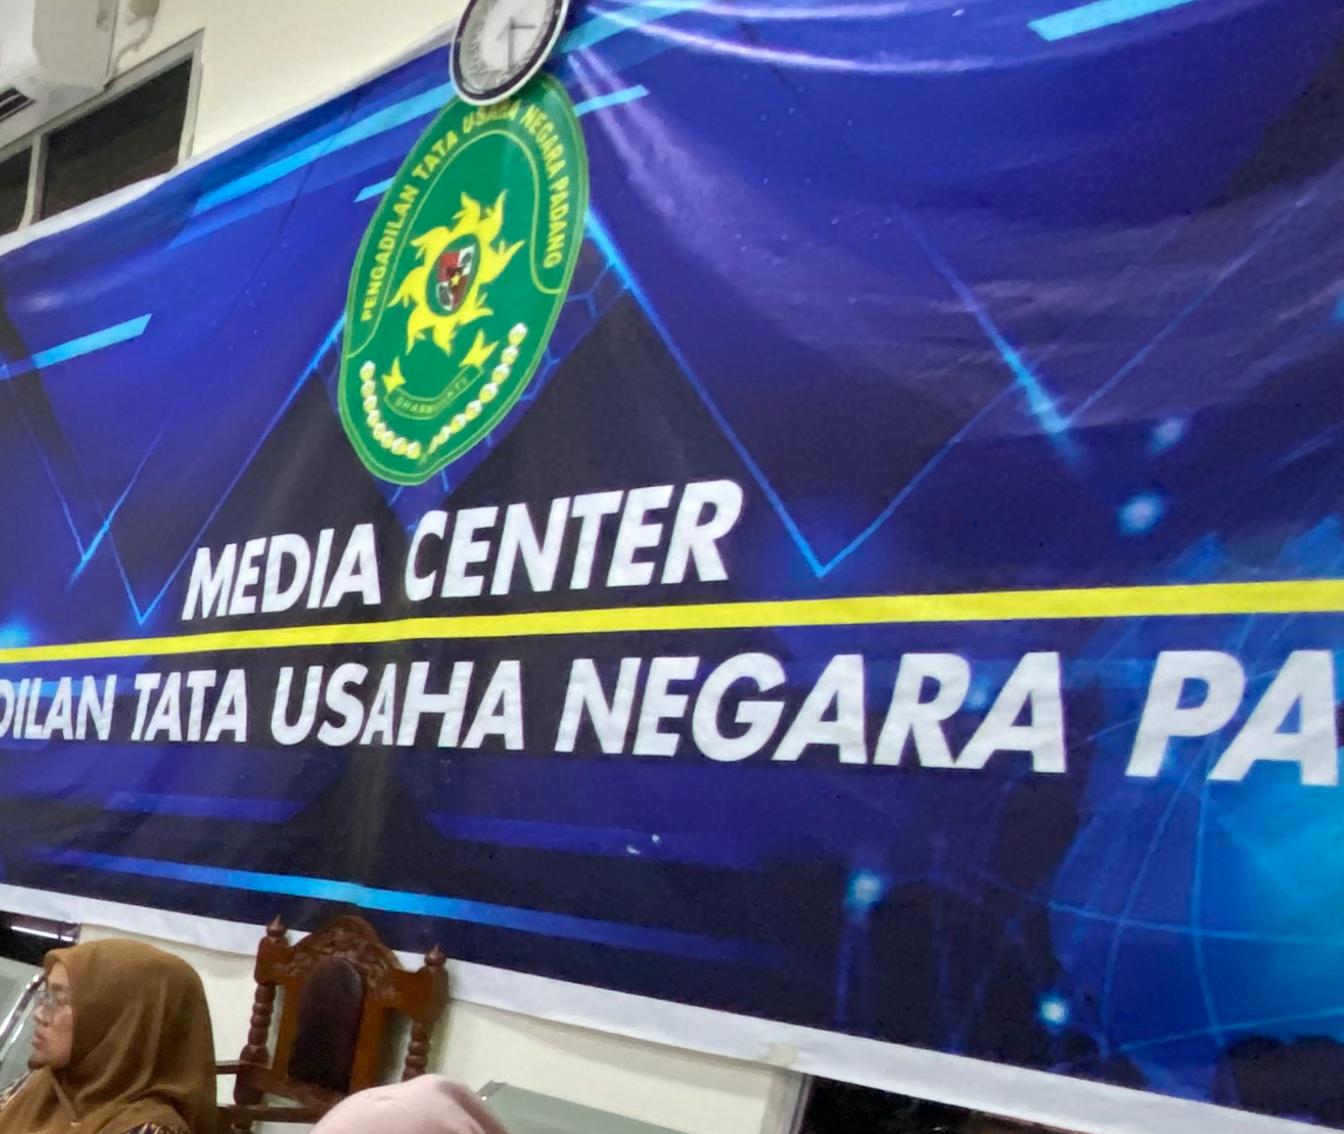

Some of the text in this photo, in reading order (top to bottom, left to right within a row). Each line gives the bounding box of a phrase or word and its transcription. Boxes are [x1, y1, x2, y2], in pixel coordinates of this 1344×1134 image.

[361, 184, 419, 321] PENGADILAN
[412, 130, 458, 180] TATA
[519, 104, 566, 179] NEGARA
[544, 176, 570, 268] PADANG
[181, 480, 744, 621] MEDIA CENTER
[130, 669, 248, 743] TATA
[269, 660, 525, 750] USAHA
[554, 651, 1068, 774] NEGARA
[1124, 649, 1340, 786] PA
